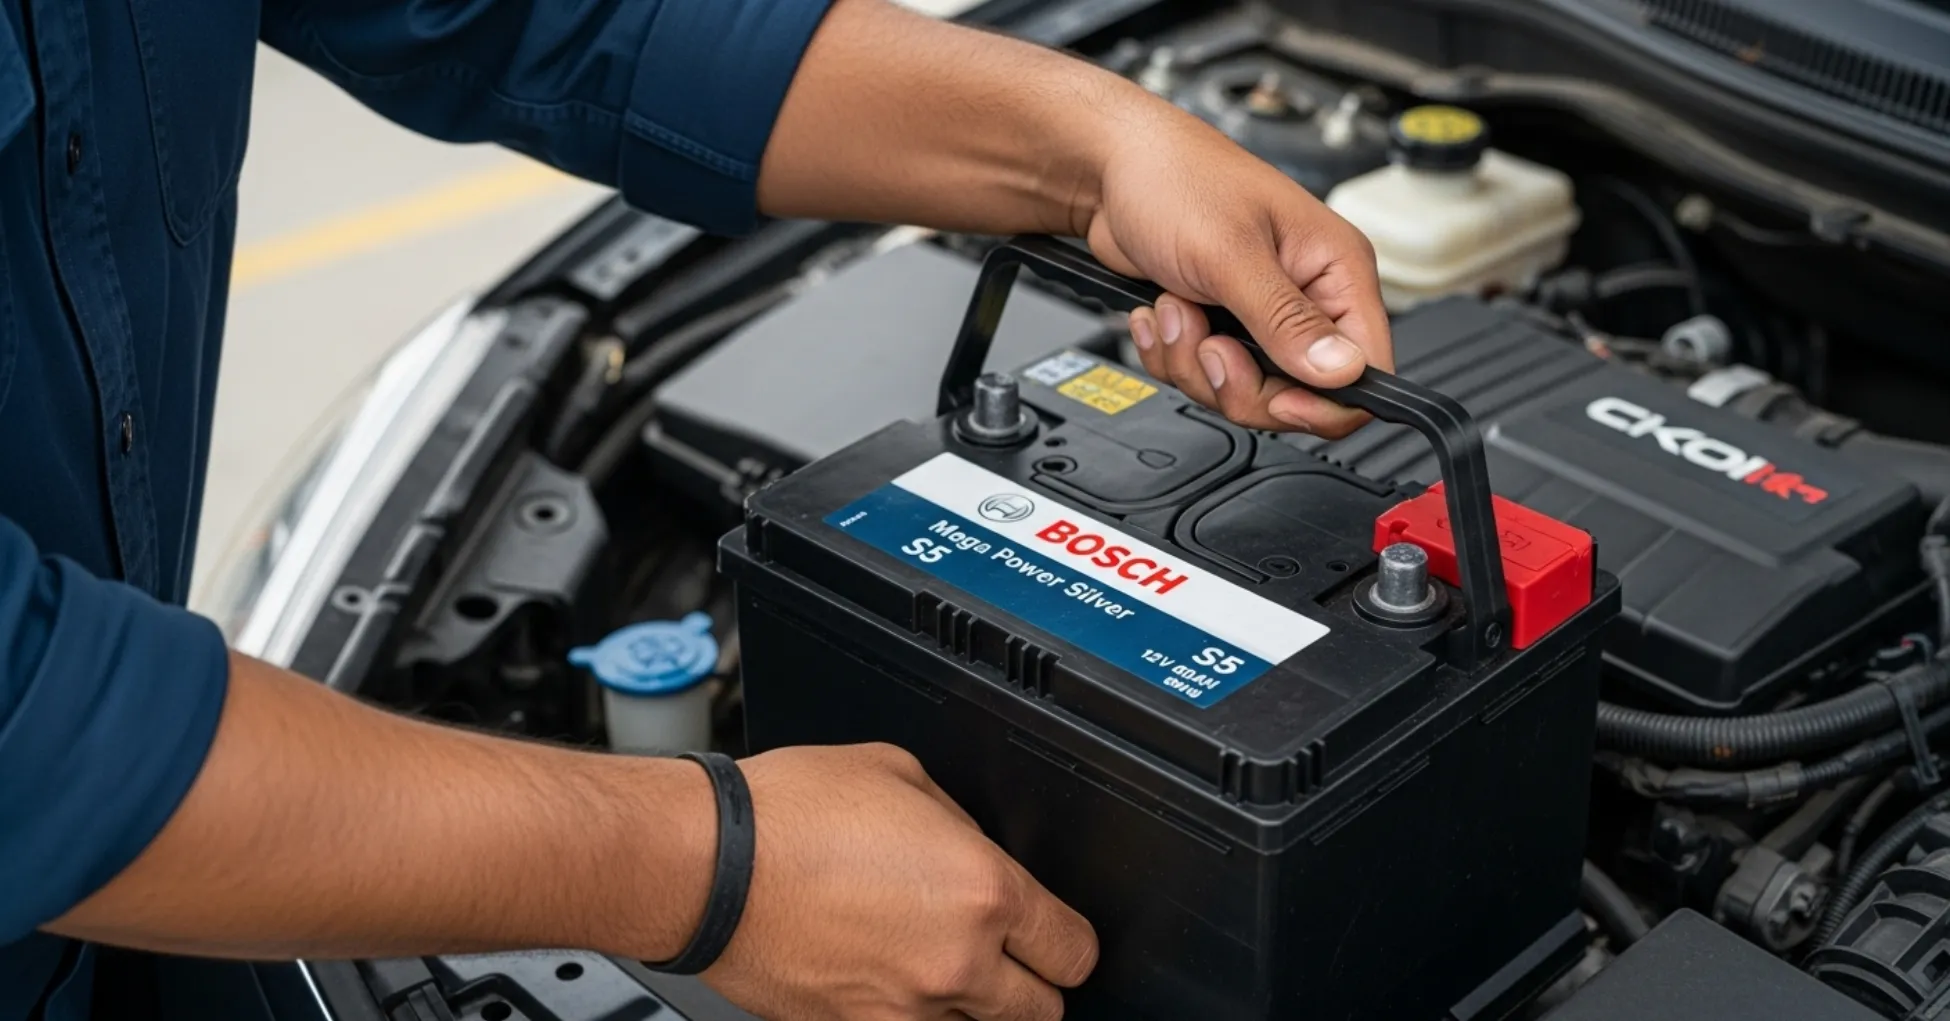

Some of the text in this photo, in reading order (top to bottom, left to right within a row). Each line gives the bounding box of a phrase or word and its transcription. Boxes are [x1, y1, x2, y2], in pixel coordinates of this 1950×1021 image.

[901, 537, 953, 563] S5
[1036, 519, 1187, 595] BOSCH
[990, 547, 1066, 587] Power
[1063, 582, 1135, 619] Silver
[1191, 647, 1245, 675] S5
